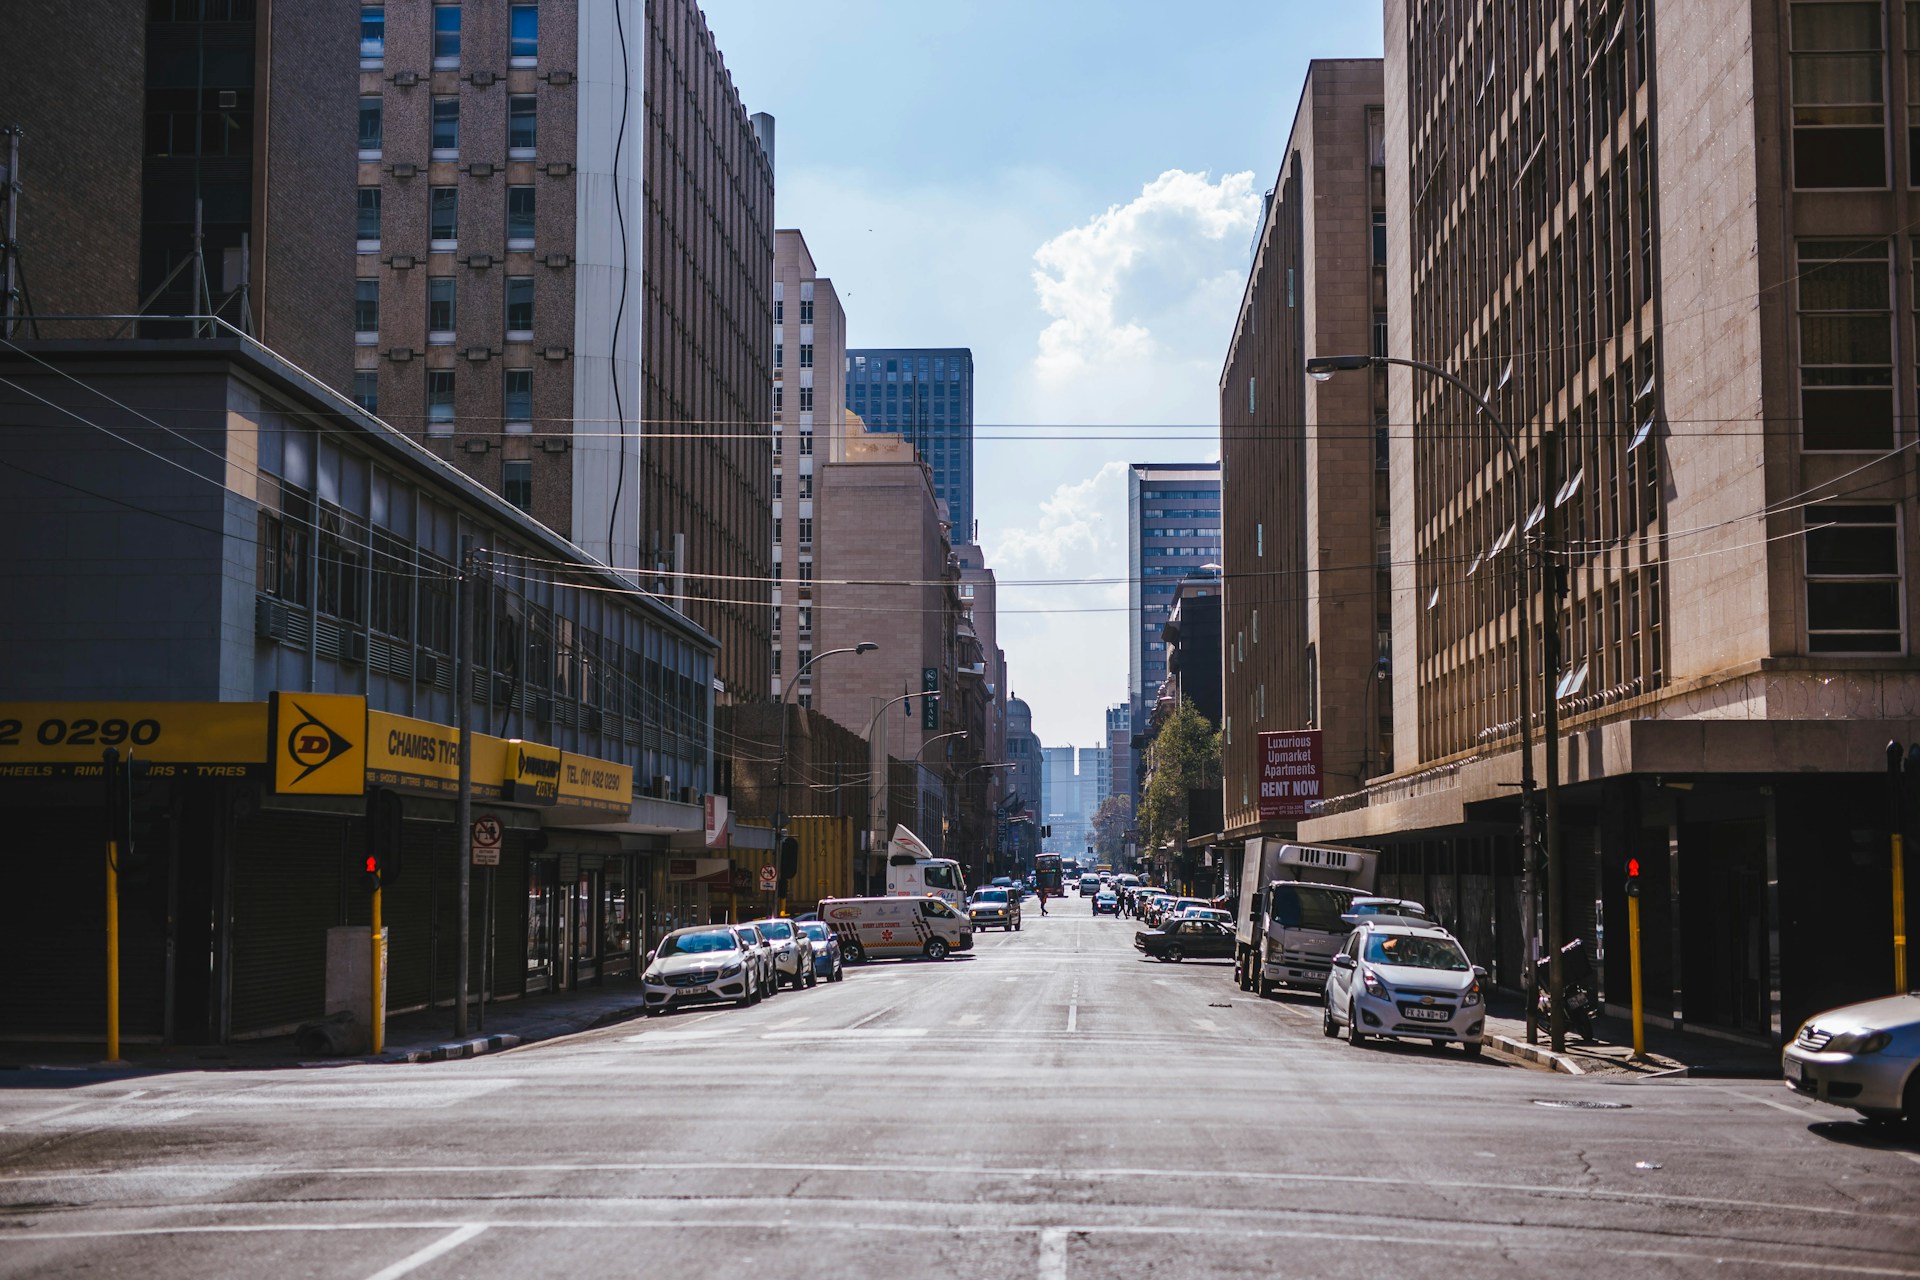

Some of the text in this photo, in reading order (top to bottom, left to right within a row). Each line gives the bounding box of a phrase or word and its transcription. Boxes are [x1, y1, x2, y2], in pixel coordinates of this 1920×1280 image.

[37, 719, 160, 745] 0290
[388, 730, 460, 766] CHAMBS TYR
[1267, 735, 1311, 748] Luxurious
[1268, 749, 1311, 765] Upmarket
[74, 766, 104, 776] RIM
[197, 766, 246, 776] TYRES
[1264, 763, 1315, 778] Apartments
[581, 768, 591, 786] 011
[605, 772, 620, 791] 0290
[1261, 780, 1319, 797] RENT NOW
